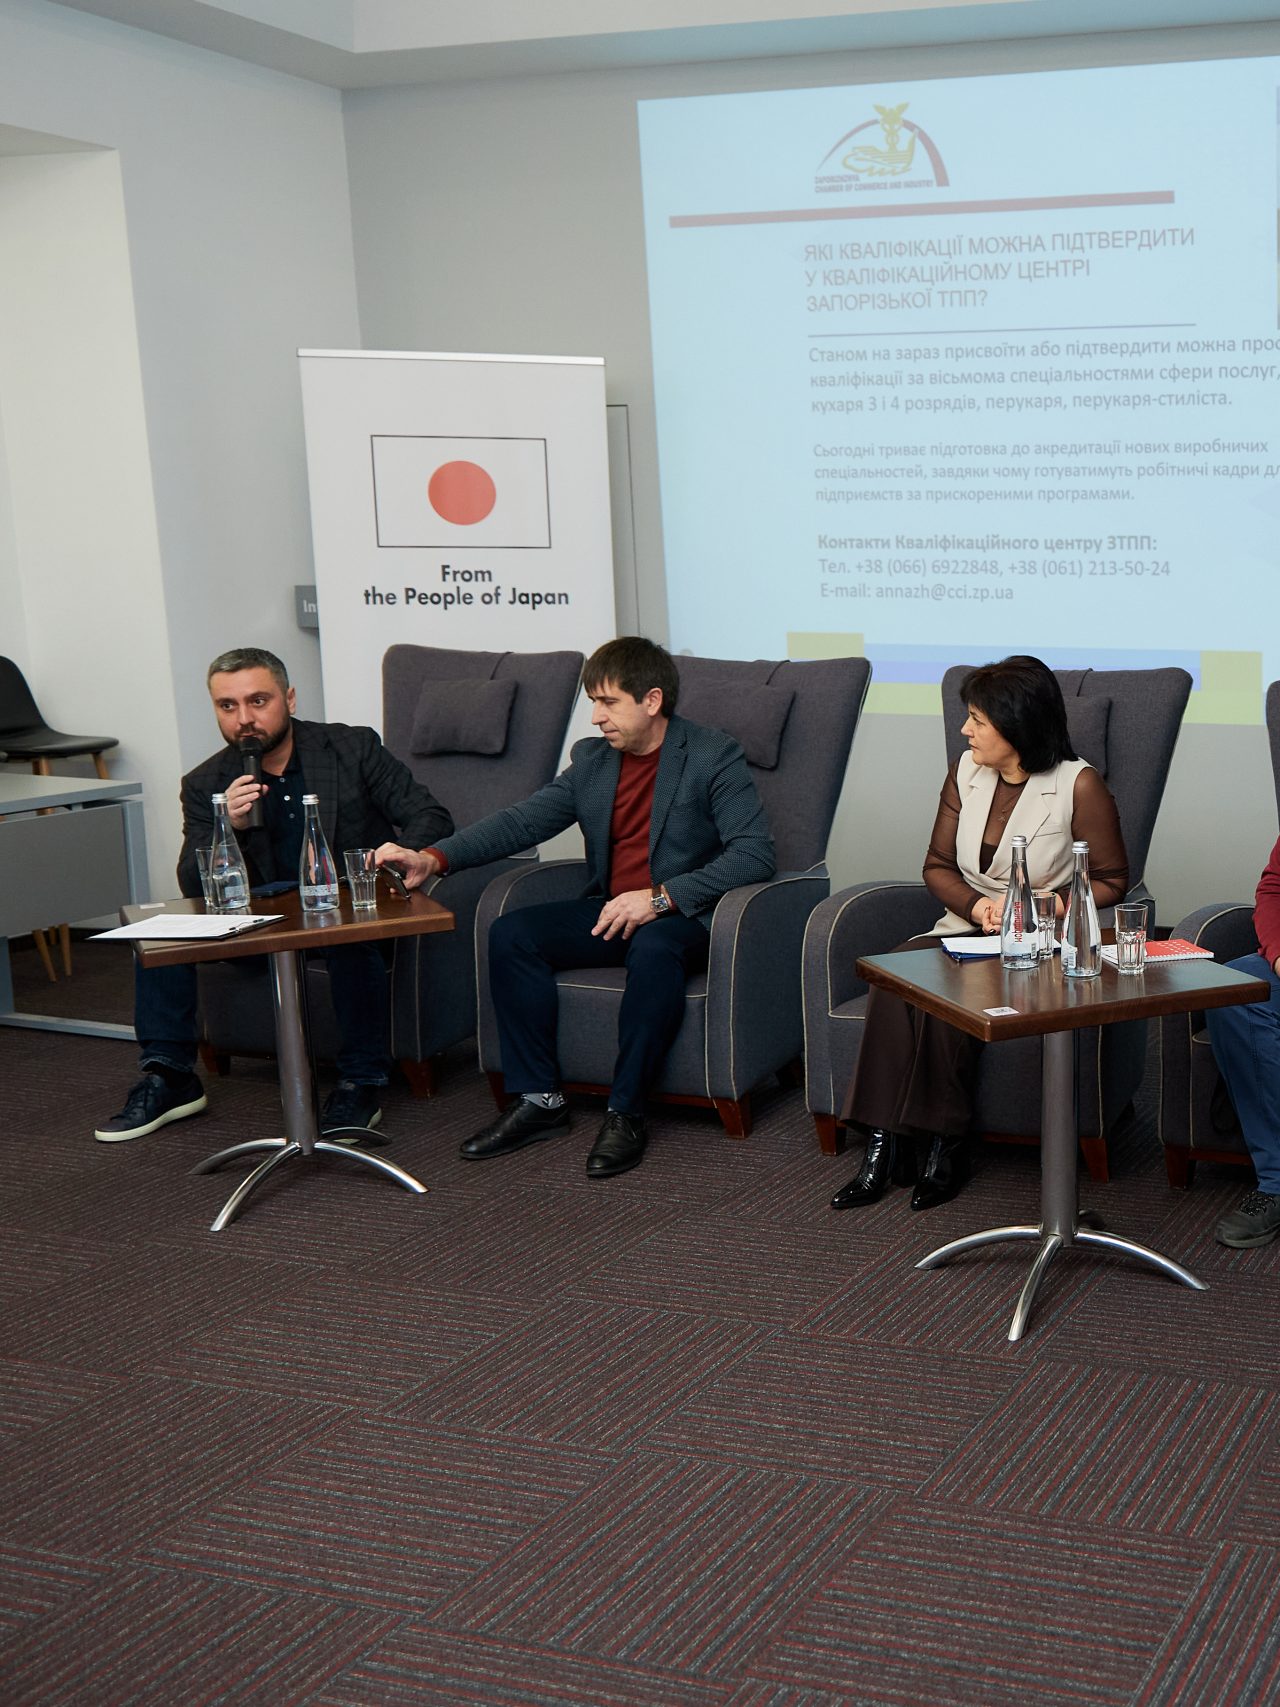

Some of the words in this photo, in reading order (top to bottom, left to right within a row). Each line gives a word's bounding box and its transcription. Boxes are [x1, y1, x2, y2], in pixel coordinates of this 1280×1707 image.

[804, 244, 833, 262] ЯКІ
[840, 235, 963, 259] КВАЛІФІКАЦІЇ
[969, 235, 1046, 254] МОЖНА
[1052, 228, 1194, 253] ПІДТВЕРДИТИ
[804, 270, 817, 287] У
[823, 261, 1012, 286] КВАЛІФІКАЦІЙНОМУ
[1018, 259, 1090, 282] ЦЕНТРІ
[807, 288, 932, 312] ЗАПОРІЗЬКОЇ
[937, 290, 988, 307] ТПП?
[809, 348, 867, 362] Станом
[872, 349, 890, 360] на
[896, 347, 940, 363] зараз
[945, 342, 1025, 362] присвоїти
[1031, 341, 1061, 356] або
[1066, 340, 1170, 358] підтвердити
[1177, 340, 1236, 352] можна
[810, 371, 903, 389] кваліфікації
[908, 374, 924, 385] за
[930, 370, 1005, 384] вісьмома
[1010, 367, 1154, 385] спеціальностями
[1160, 363, 1213, 383] сфери
[1219, 366, 1280, 381] послуг,
[812, 400, 863, 415] кухаря
[869, 396, 877, 411] 3
[882, 396, 886, 411] і
[890, 396, 899, 410] 4
[905, 395, 980, 414] розрядів,
[986, 396, 1067, 412] перукаря,
[1073, 390, 1232, 411] перукаря-стиліста.
[813, 443, 874, 459] Сьогодні
[878, 446, 926, 459] триває
[931, 442, 1007, 458] підготовка
[1011, 445, 1030, 457] до
[1034, 440, 1121, 458] акредитації
[1125, 443, 1169, 454] нових
[1175, 438, 1268, 456] виробничих
[814, 464, 927, 480] спеціальностей,
[932, 467, 989, 480] завдяки
[993, 467, 1030, 480] чому
[1035, 466, 1133, 480] готуватимуть
[1137, 462, 1208, 480] робітничі
[1213, 465, 1259, 479] кадри
[816, 488, 903, 504] підприємств
[907, 490, 921, 500] за
[926, 490, 1033, 503] прискореними
[1038, 489, 1134, 503] програмами.
[818, 535, 890, 549] Контакти
[896, 534, 1039, 553] Кваліфікаційного
[1044, 539, 1103, 553] центру
[1107, 536, 1157, 550] ЗТПП:
[441, 565, 492, 582] From
[818, 559, 850, 573] Тел.
[856, 559, 883, 573] +38
[888, 559, 926, 577] (066)
[932, 560, 1003, 577] 6922848,
[1008, 560, 1037, 575] +38
[1042, 560, 1083, 578] (061)
[1088, 561, 1170, 576] 213-50-24
[364, 586, 396, 605] the
[405, 586, 473, 610] People
[481, 586, 501, 605] of
[509, 588, 568, 610] Japan
[821, 583, 871, 597] E-mail:
[876, 584, 1013, 602] annazh@cci.zp.ua
